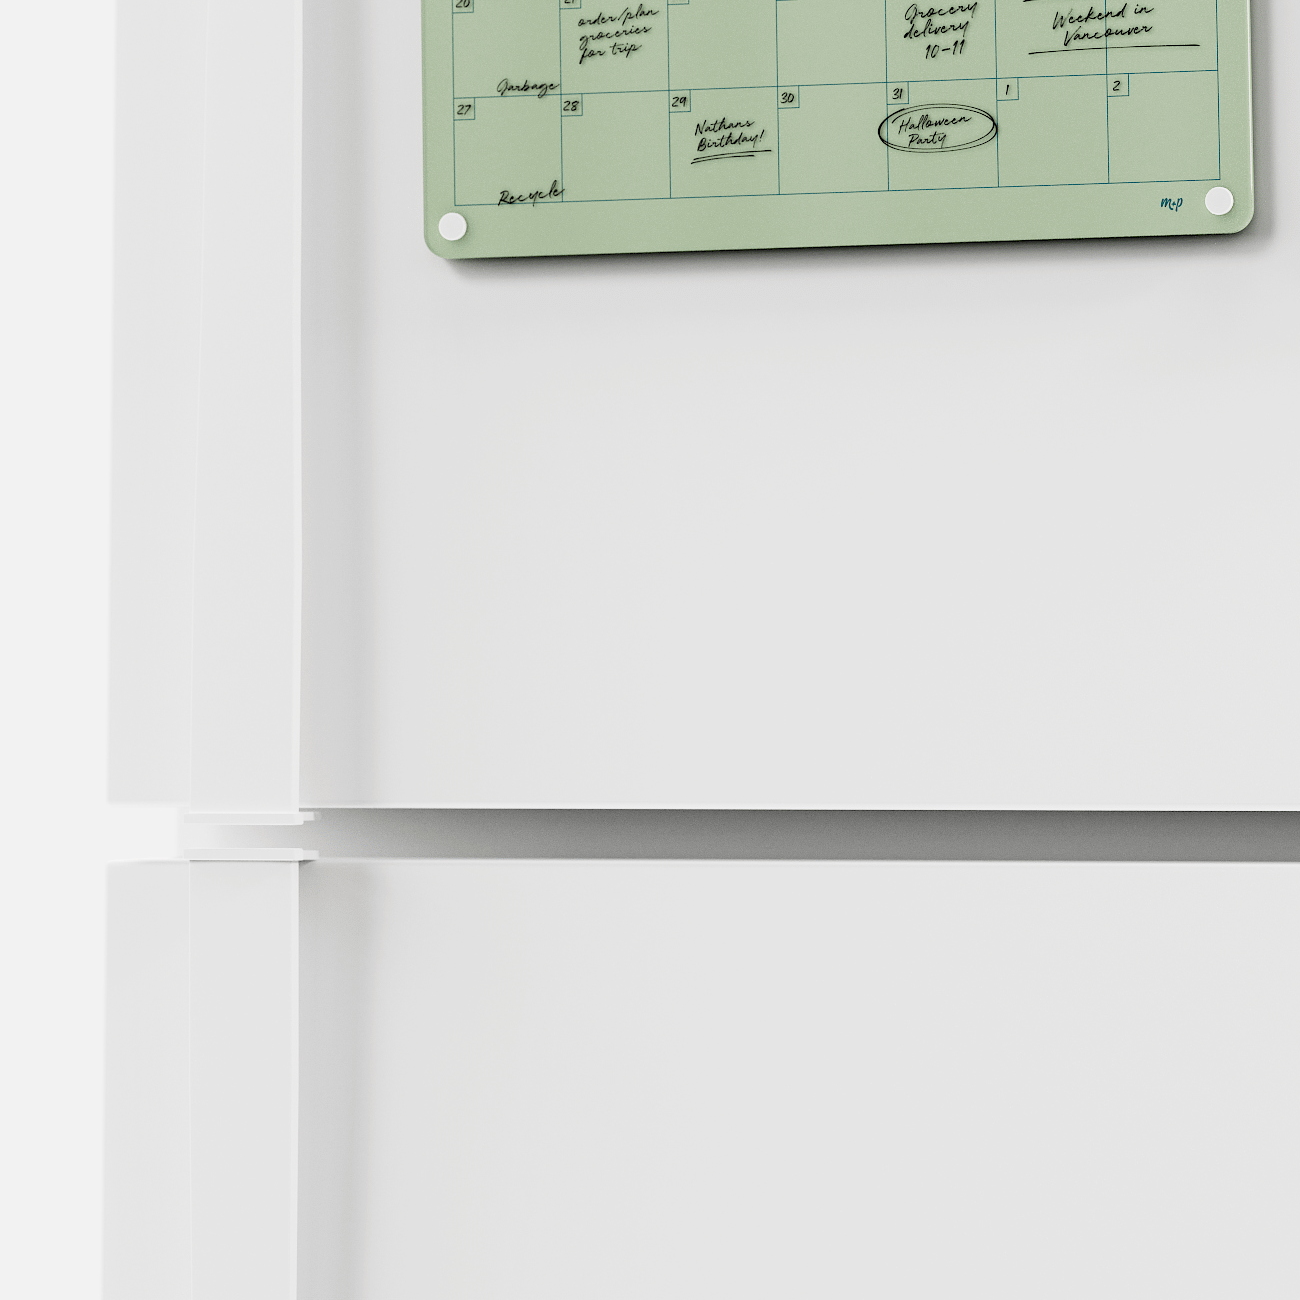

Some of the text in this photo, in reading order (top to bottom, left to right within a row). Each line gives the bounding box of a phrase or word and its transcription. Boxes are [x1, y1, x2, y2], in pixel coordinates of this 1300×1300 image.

[578, 5, 659, 27] order/plan
[904, 1, 978, 22] Grocery
[1053, 3, 1154, 30] Weekend in
[579, 26, 651, 49] groceries
[904, 20, 969, 39] delivery
[1064, 24, 1152, 47] Vancouver
[579, 42, 642, 64] for trip
[497, 79, 560, 97] Garbage
[891, 87, 905, 101] 31
[1004, 84, 1010, 96] 1
[1112, 79, 1122, 92] 2
[563, 99, 580, 113] 28
[671, 95, 688, 109] 29
[781, 91, 795, 105] 30
[456, 104, 472, 116] 27
[695, 119, 755, 137] Nathans
[898, 115, 972, 134] Halloween
[697, 130, 765, 152] Birthday!
[908, 133, 947, 149] Party
[498, 180, 565, 206] Recycle
